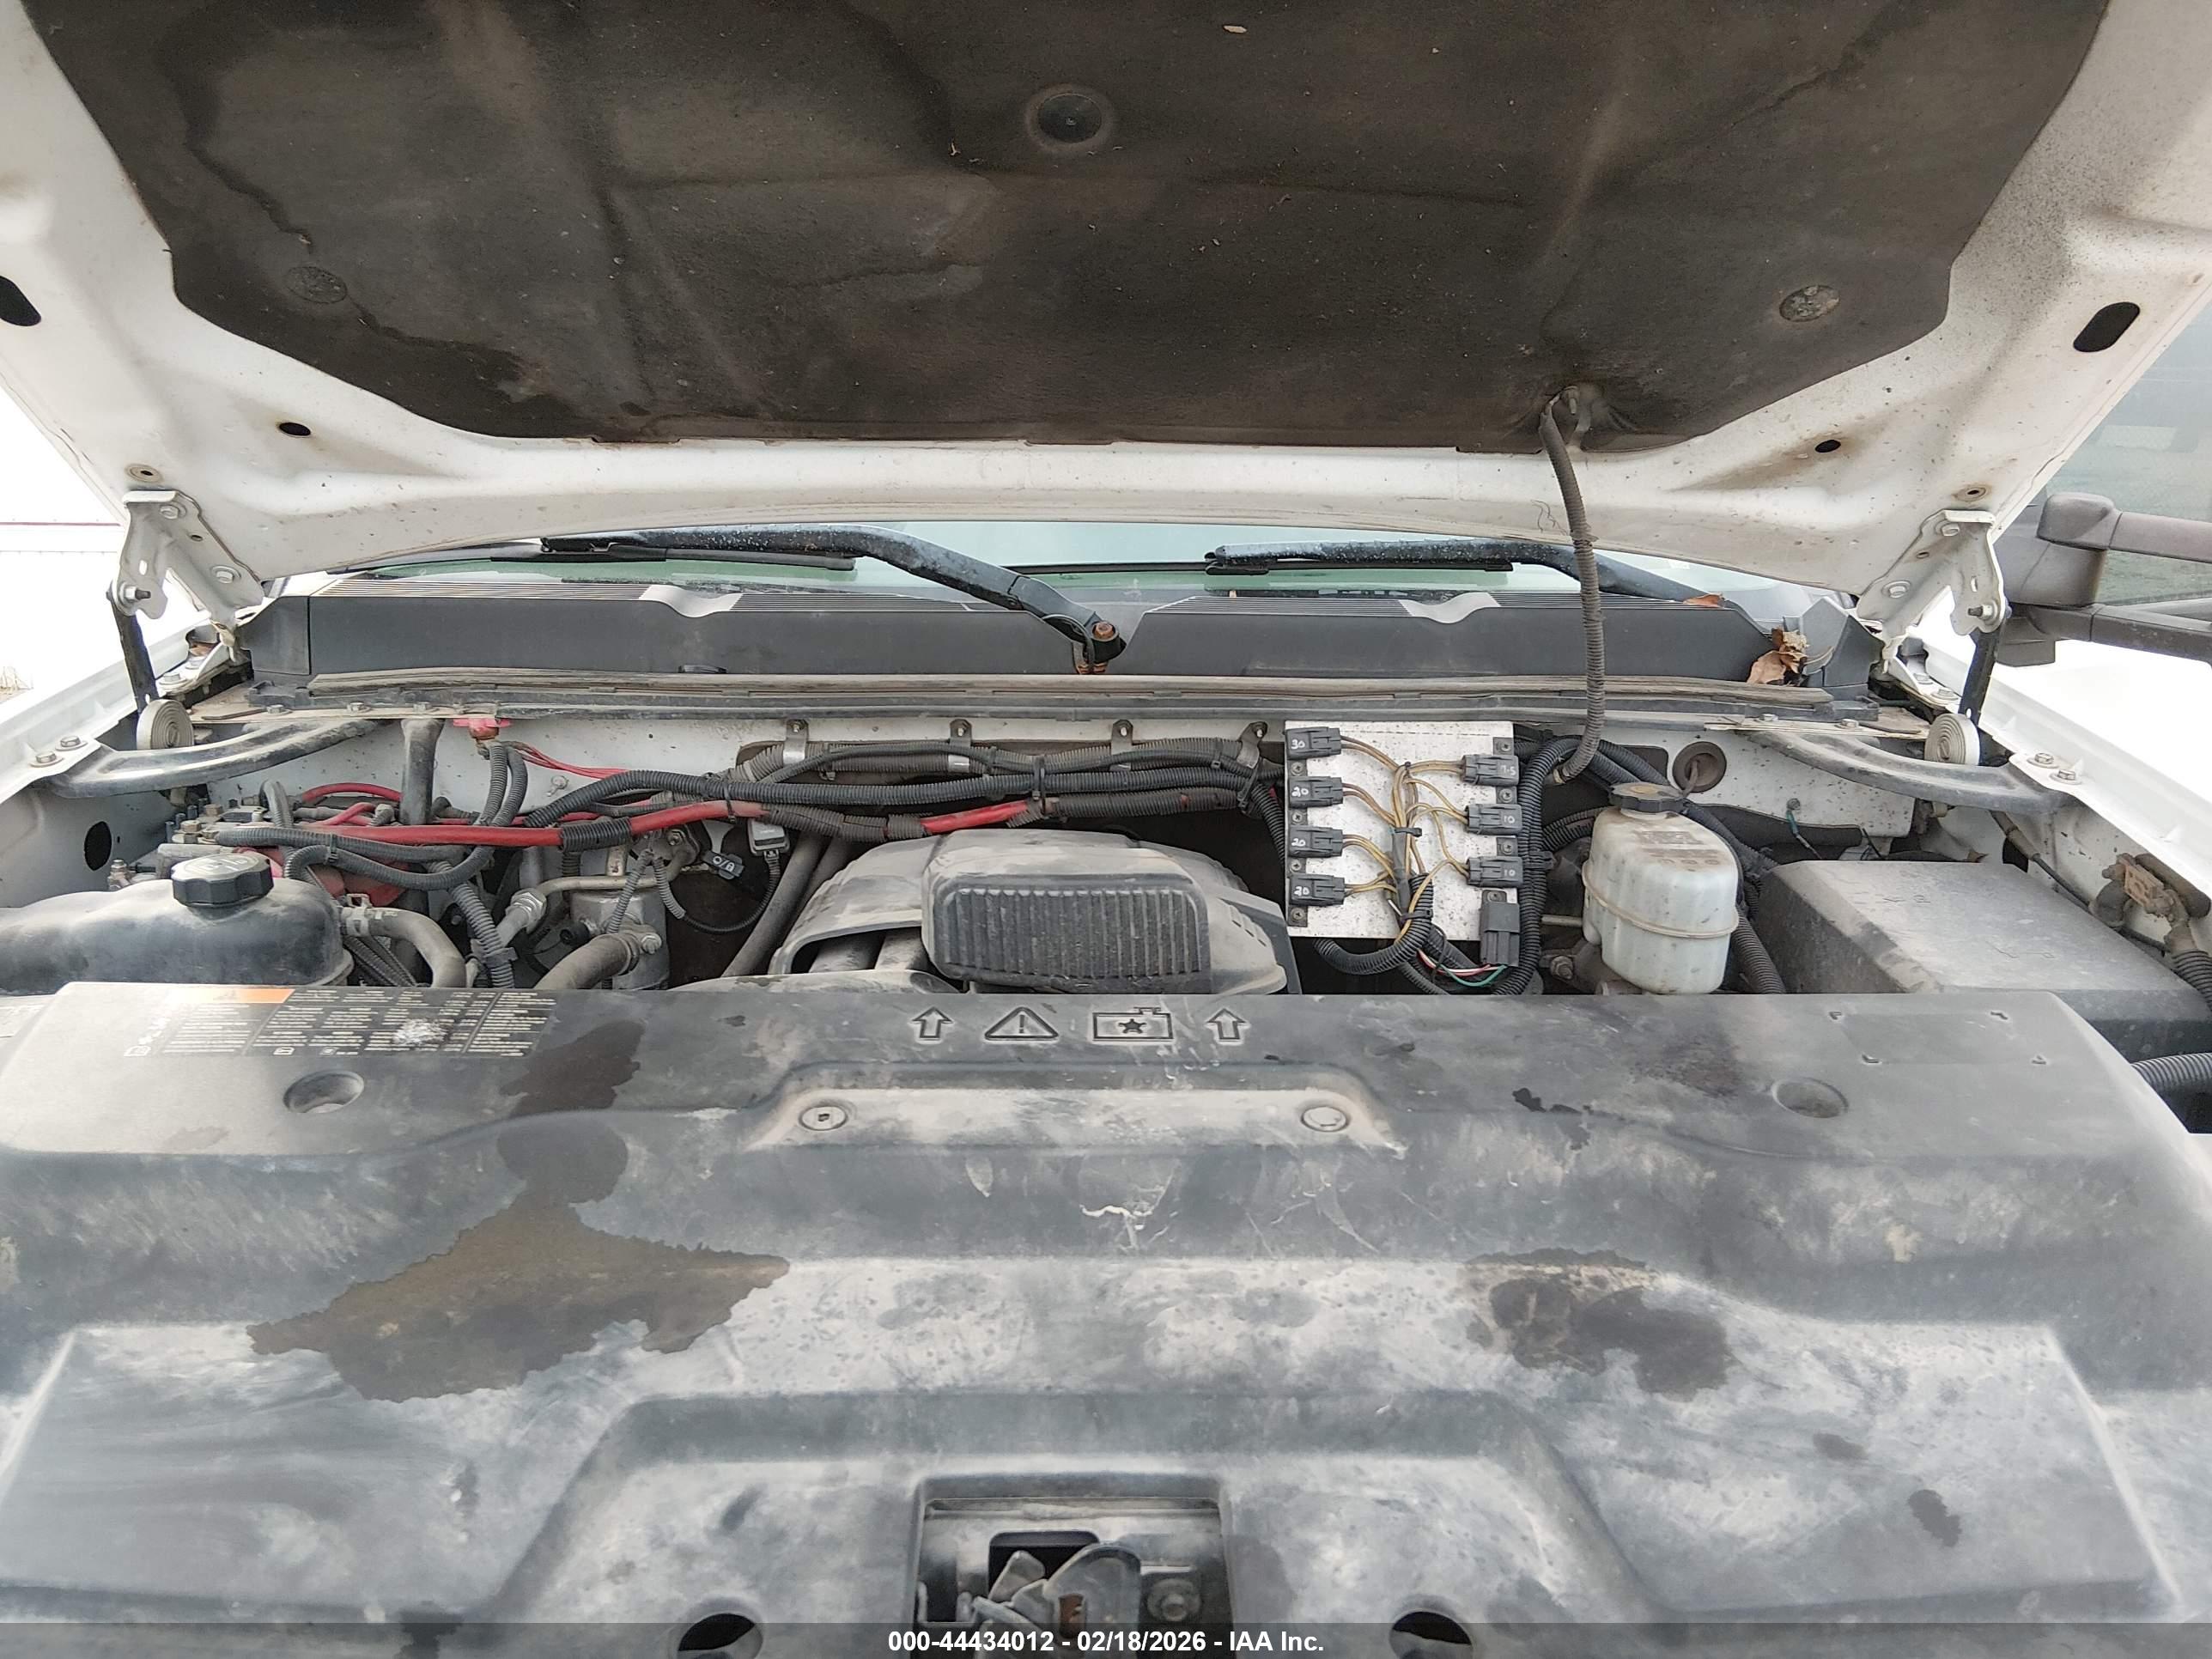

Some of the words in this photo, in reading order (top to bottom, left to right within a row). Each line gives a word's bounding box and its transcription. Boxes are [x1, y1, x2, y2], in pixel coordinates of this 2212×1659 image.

[1291, 738, 1305, 750] 30
[1504, 815, 1516, 823] 10
[1291, 837, 1306, 847] 20
